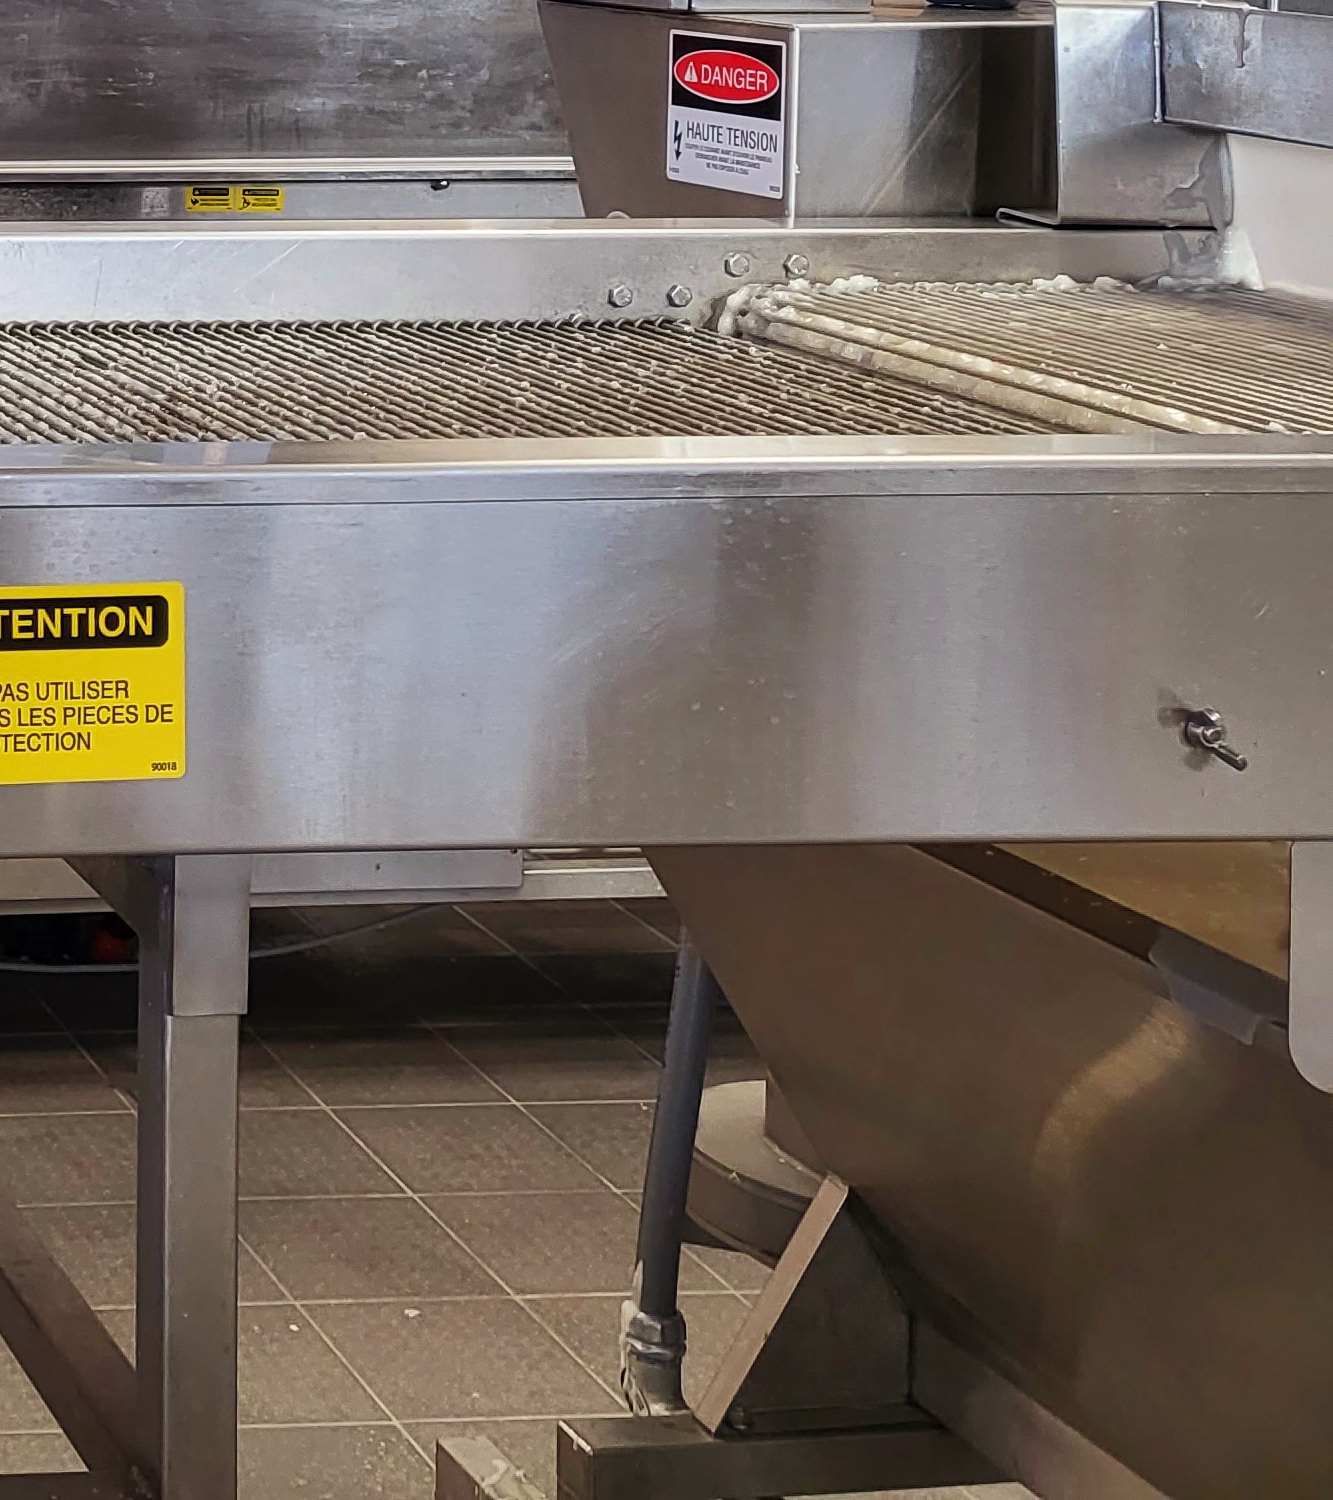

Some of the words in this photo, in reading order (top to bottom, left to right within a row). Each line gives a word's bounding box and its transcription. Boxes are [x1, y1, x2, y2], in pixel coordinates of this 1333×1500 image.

[701, 64, 768, 92] DANGER
[686, 120, 724, 145] HAUTE
[726, 127, 778, 153] TENSION
[35, 679, 130, 701] UTILISER
[17, 707, 57, 727] LES
[63, 705, 139, 726] PIECES
[145, 704, 174, 723] DE
[151, 762, 178, 772] 90018
